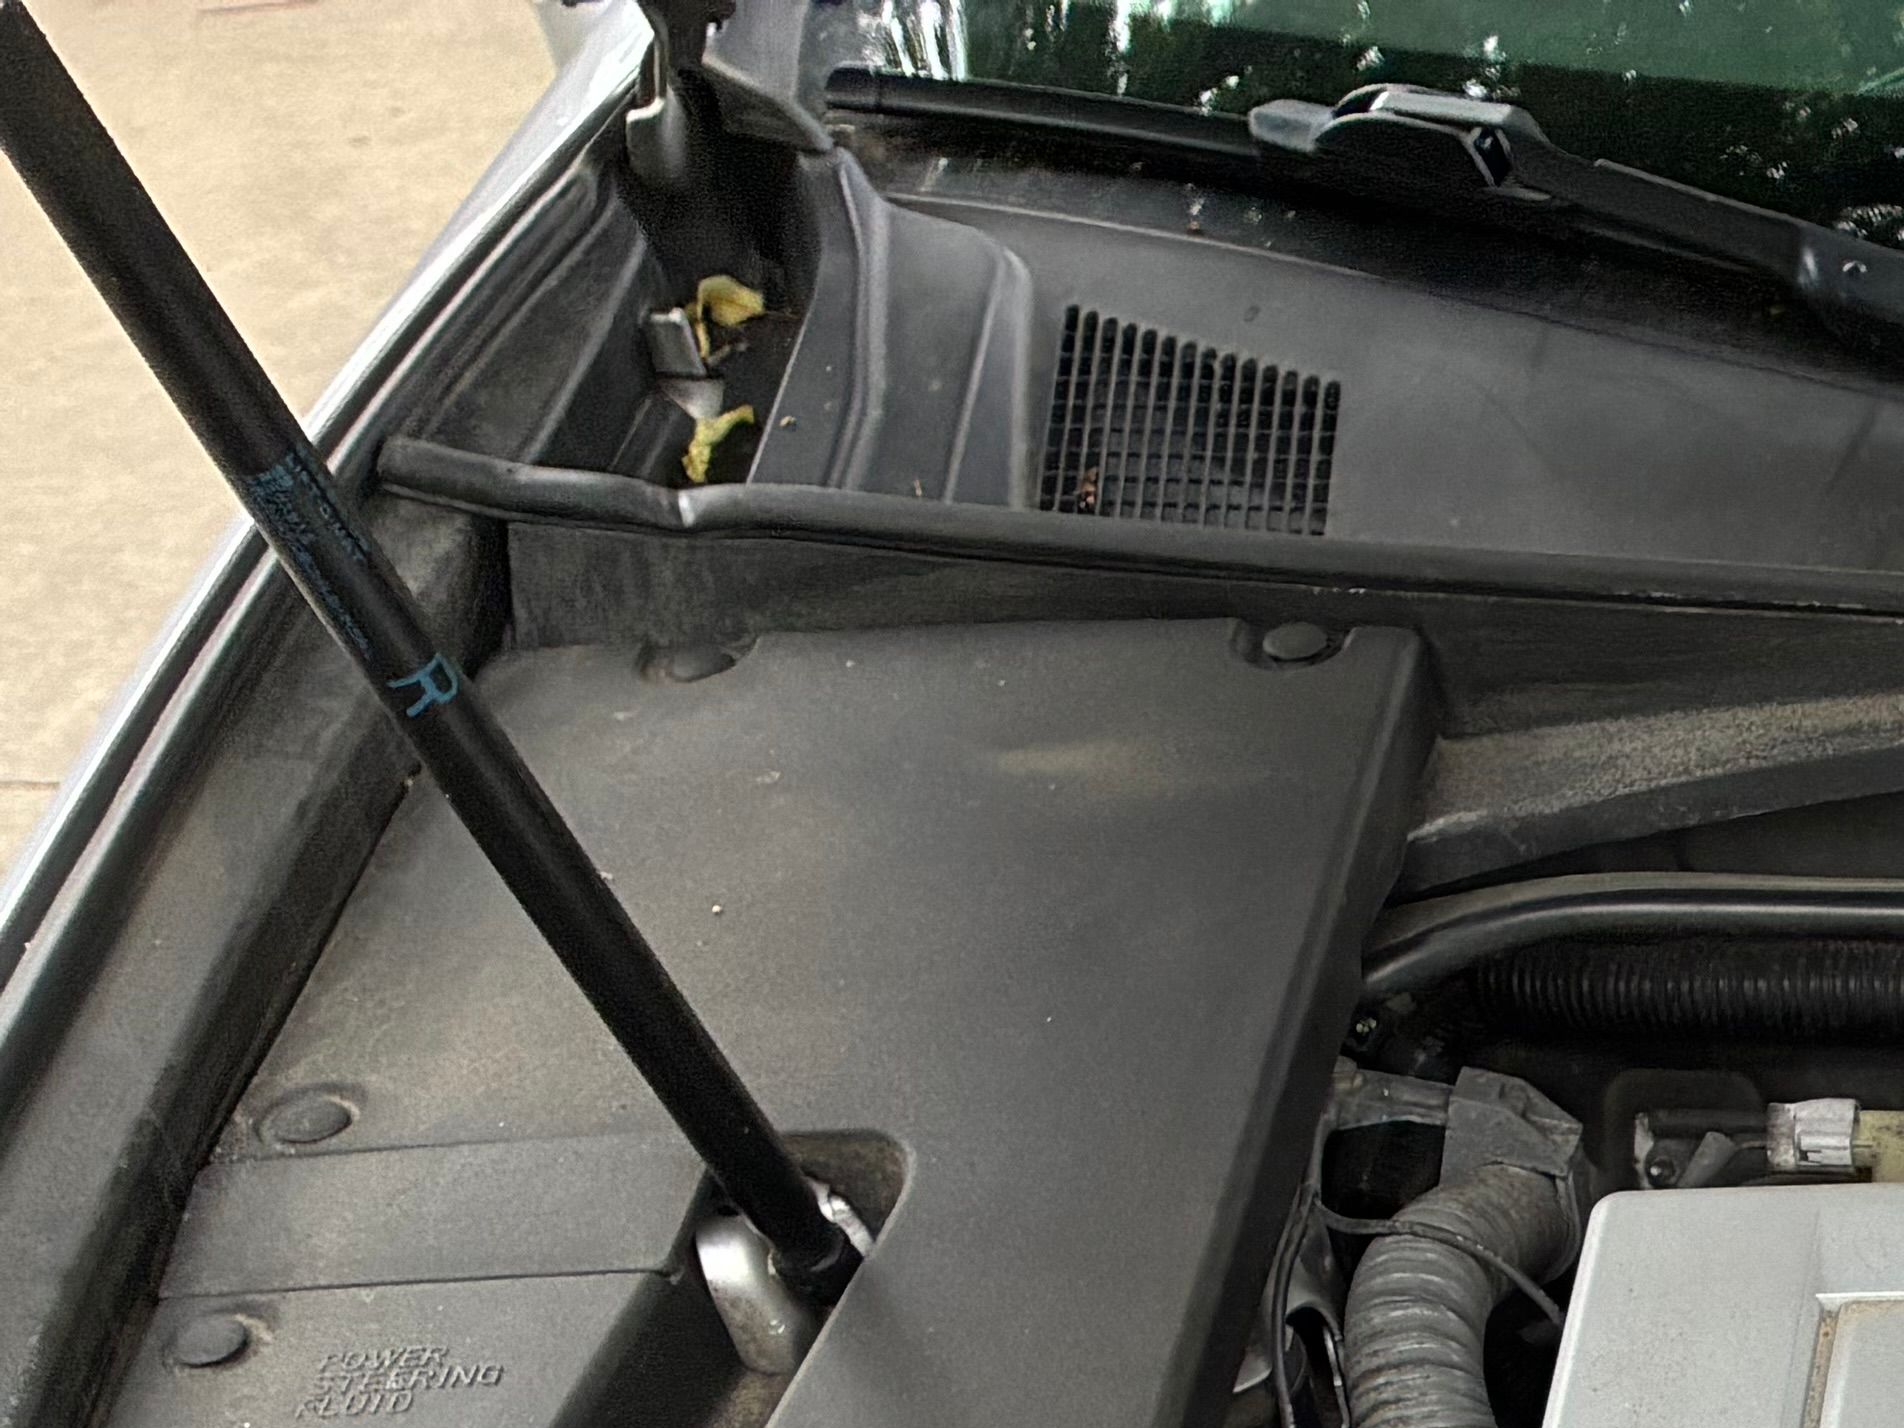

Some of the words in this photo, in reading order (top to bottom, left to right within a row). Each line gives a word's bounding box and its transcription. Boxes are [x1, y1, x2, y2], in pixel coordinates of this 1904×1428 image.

[386, 652, 459, 718] R
[319, 1344, 449, 1373] POWER
[310, 1363, 505, 1396] STEERING
[294, 1388, 415, 1421] FLUID
